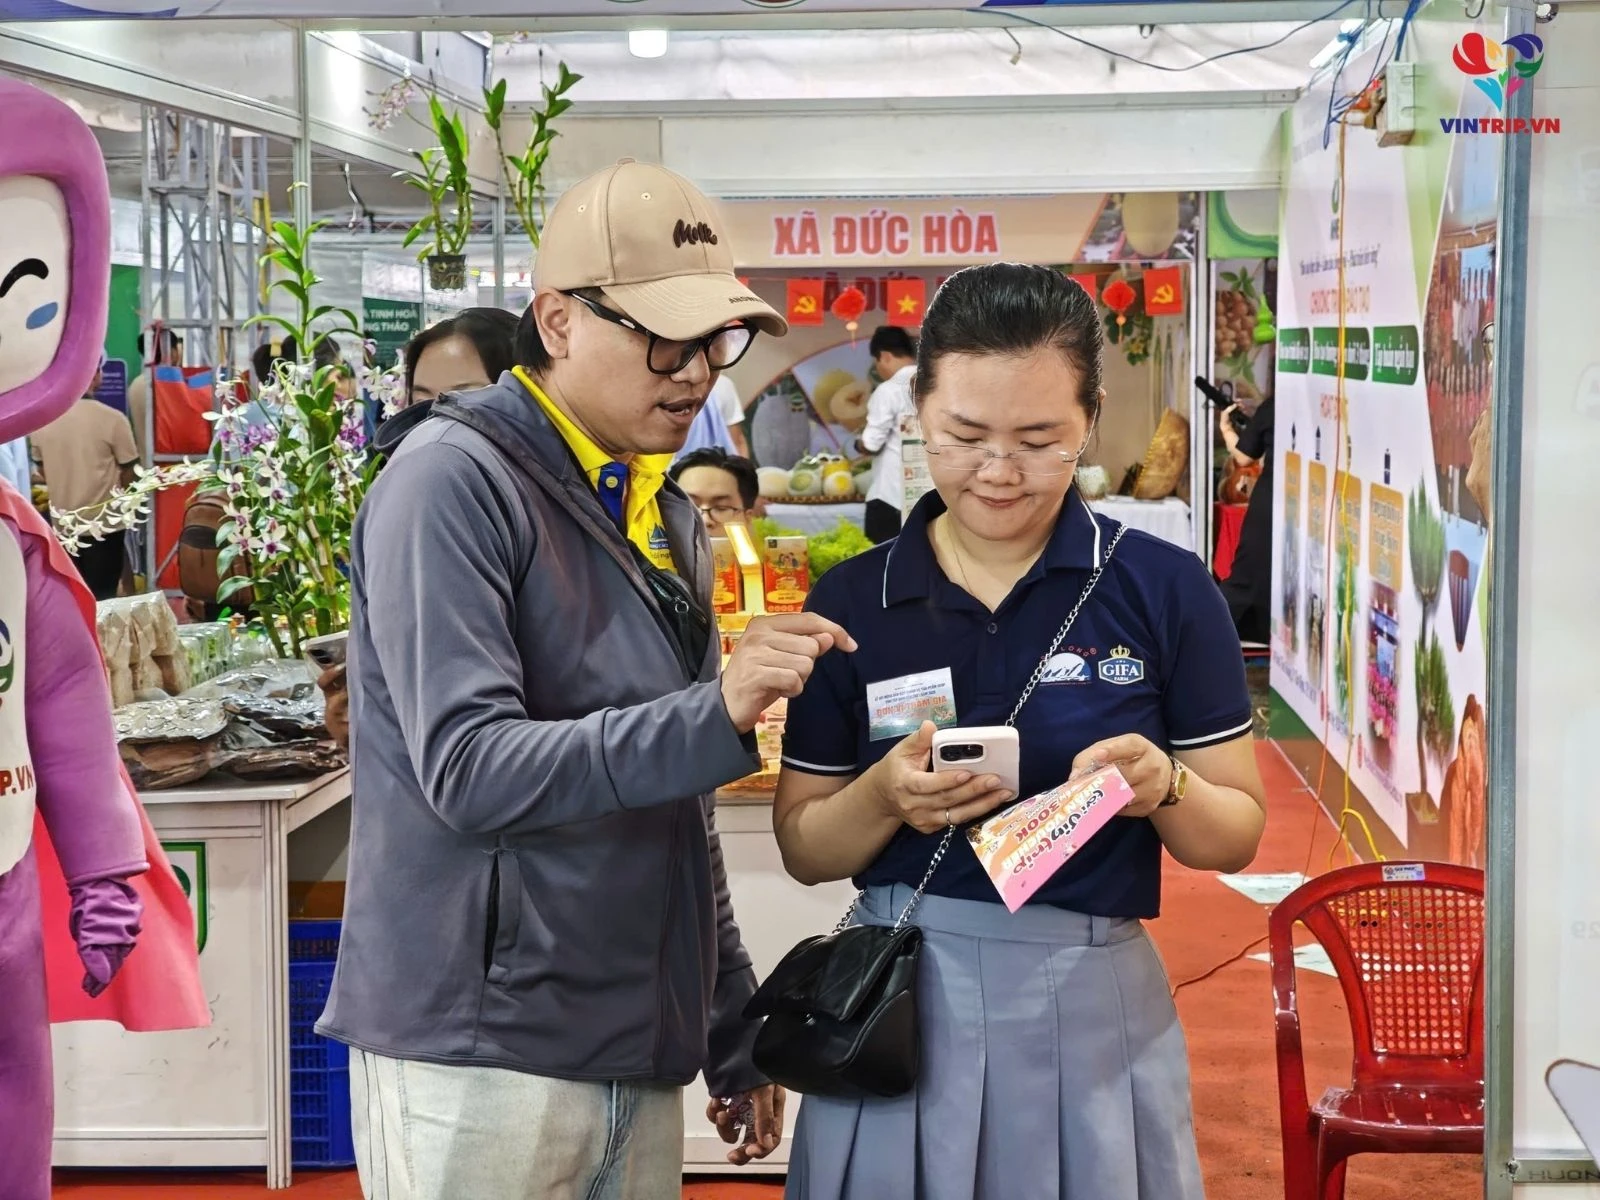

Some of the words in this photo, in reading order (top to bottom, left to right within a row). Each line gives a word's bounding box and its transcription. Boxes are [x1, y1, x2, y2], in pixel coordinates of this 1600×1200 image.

[774, 210, 821, 255] XÃ
[833, 208, 909, 255] ĐỨC
[923, 208, 998, 254] HÒA
[1102, 664, 1139, 676] GIFA
[1015, 800, 1060, 842] 300K
